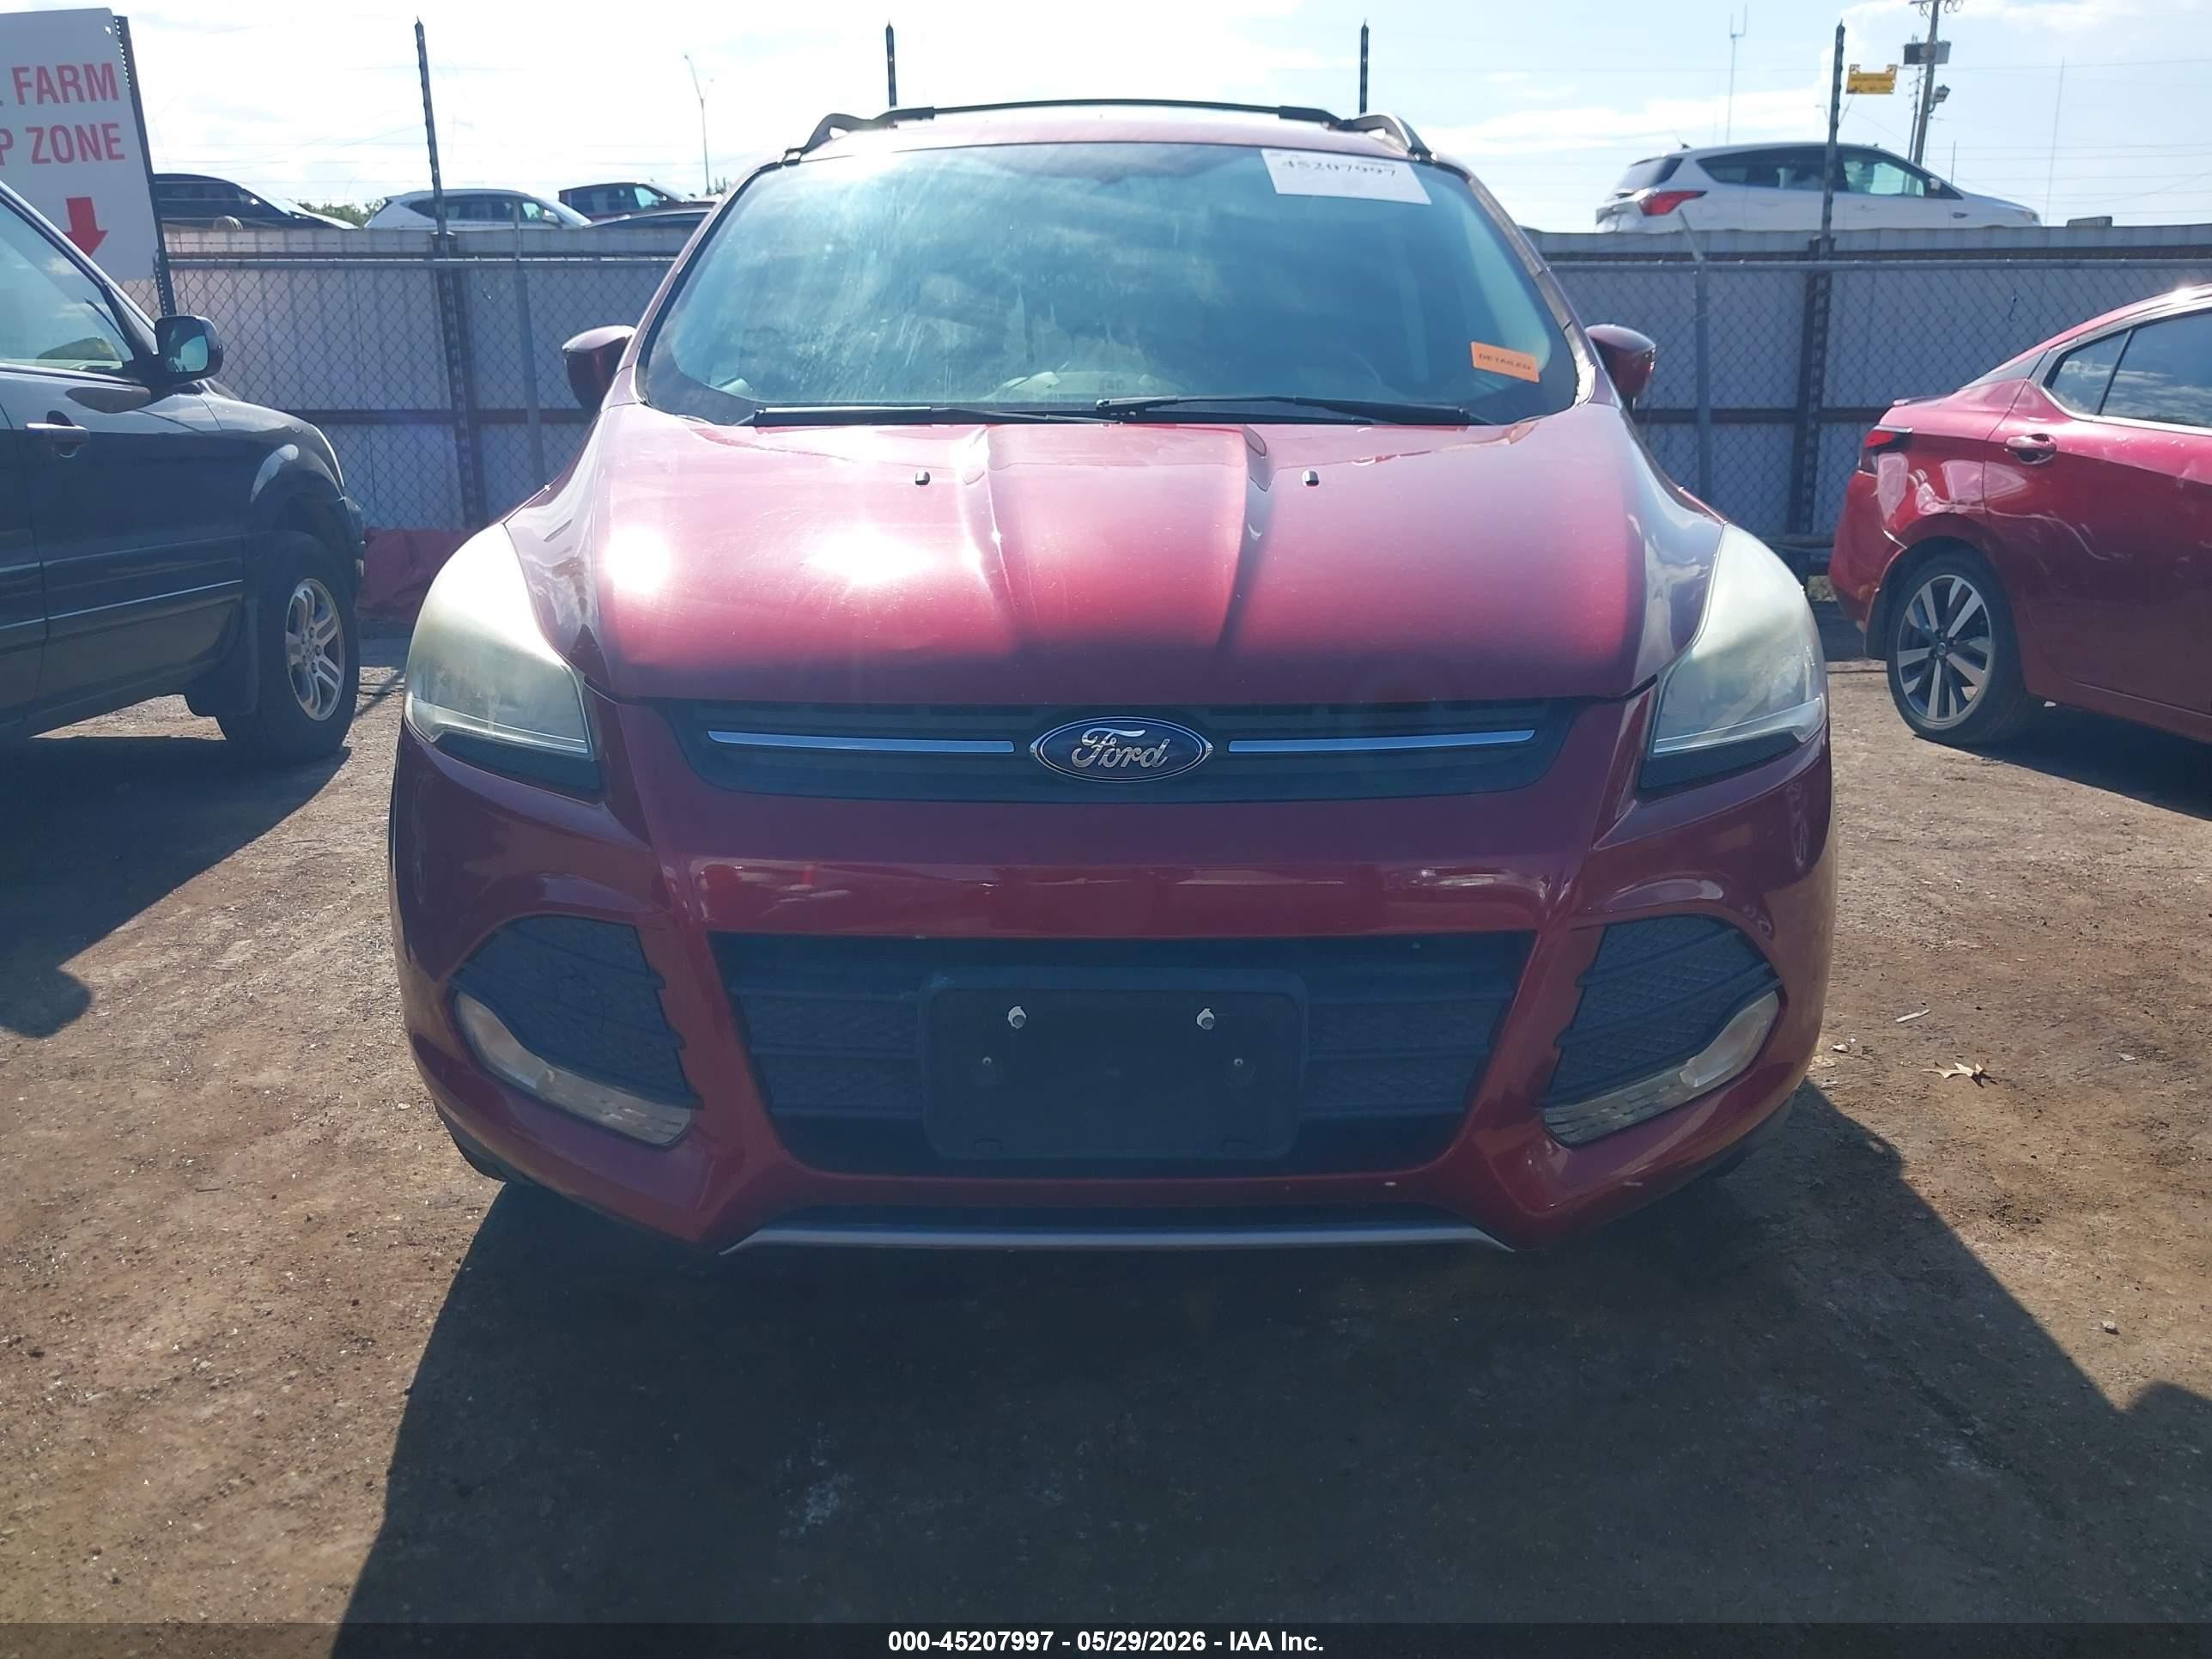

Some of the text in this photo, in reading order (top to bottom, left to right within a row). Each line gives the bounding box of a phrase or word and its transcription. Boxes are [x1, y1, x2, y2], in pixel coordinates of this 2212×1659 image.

[12, 63, 119, 105] FARM
[26, 123, 125, 164] ZONE
[1071, 727, 1170, 768] Ford
